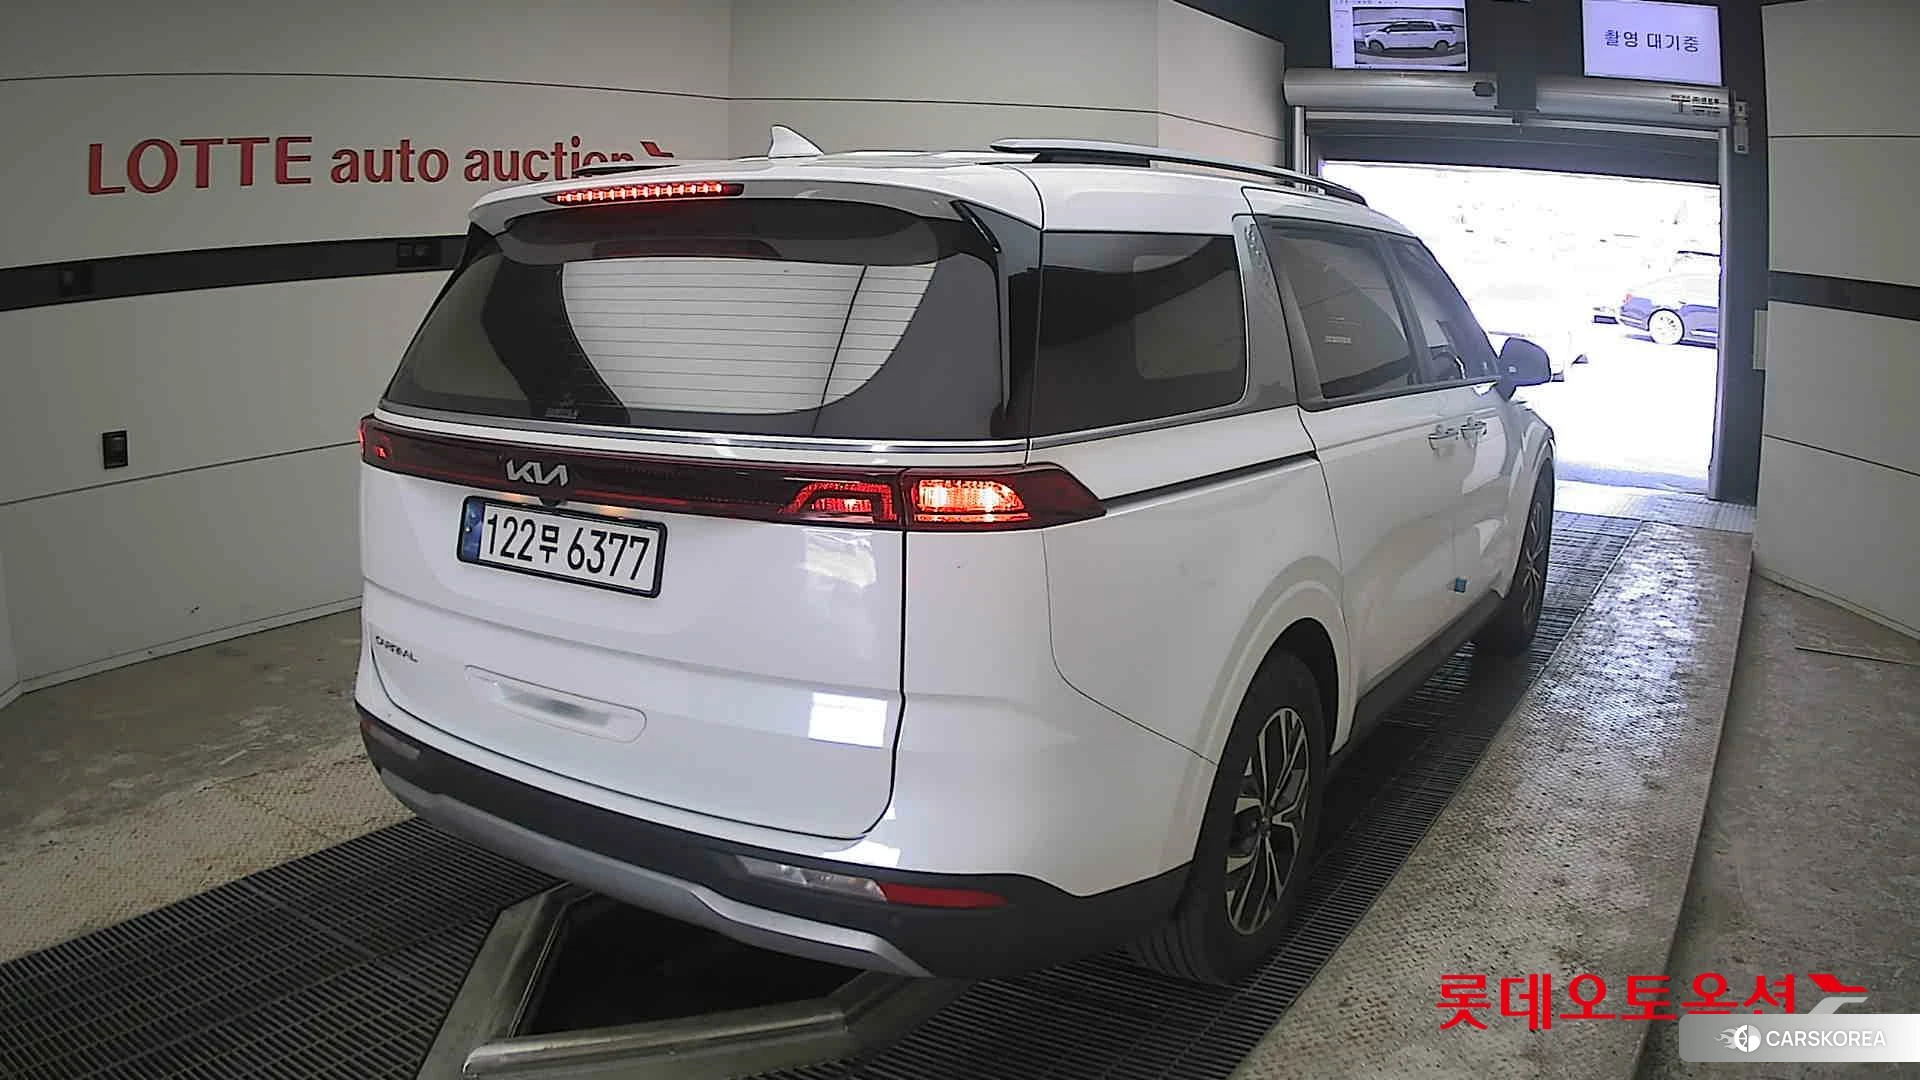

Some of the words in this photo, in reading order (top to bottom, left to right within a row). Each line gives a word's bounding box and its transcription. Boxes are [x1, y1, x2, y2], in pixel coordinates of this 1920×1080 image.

[1604, 29, 1639, 48] 촬영
[1646, 32, 1699, 53] 대기중
[88, 136, 313, 195] LOTTE
[330, 139, 449, 184] auto
[505, 459, 569, 488] KIA
[486, 513, 561, 564] 122무
[566, 526, 651, 581] 6377
